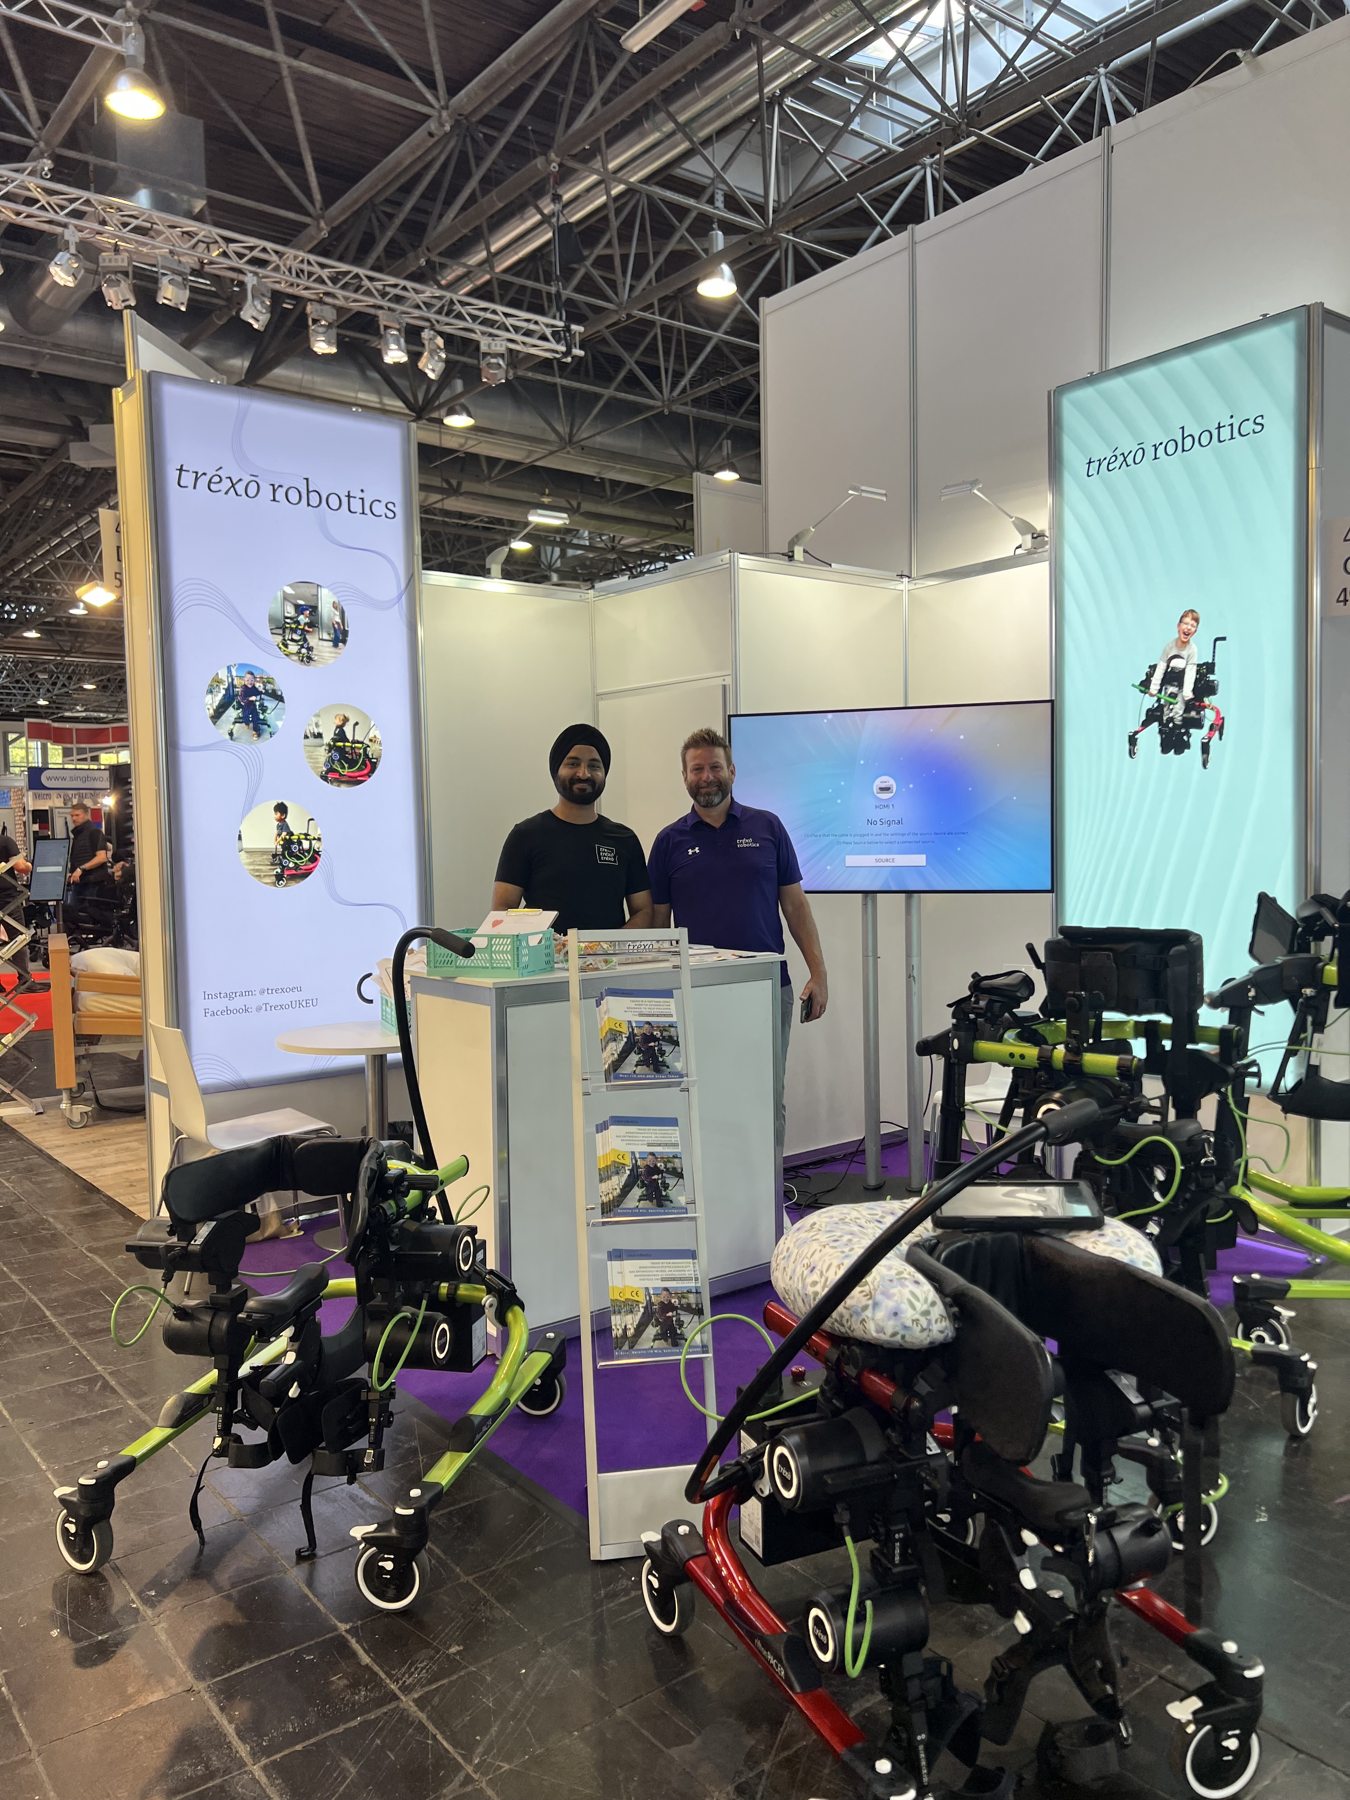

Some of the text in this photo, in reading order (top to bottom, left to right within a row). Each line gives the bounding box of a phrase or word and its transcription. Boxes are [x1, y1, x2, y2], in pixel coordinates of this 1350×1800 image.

[1086, 414, 1265, 478] tréxō robotics
[175, 463, 397, 521] tréxō robotics
[1336, 587, 1350, 607] 4
[866, 817, 904, 828] No Signal
[202, 985, 302, 1001] Instagram: @trexoeu
[203, 998, 319, 1018] Facebook: @TrexoUKEU
[613, 1022, 623, 1030] CE
[616, 1153, 626, 1161] CE
[630, 1290, 639, 1298] CE
[767, 1651, 785, 1679] PACER
